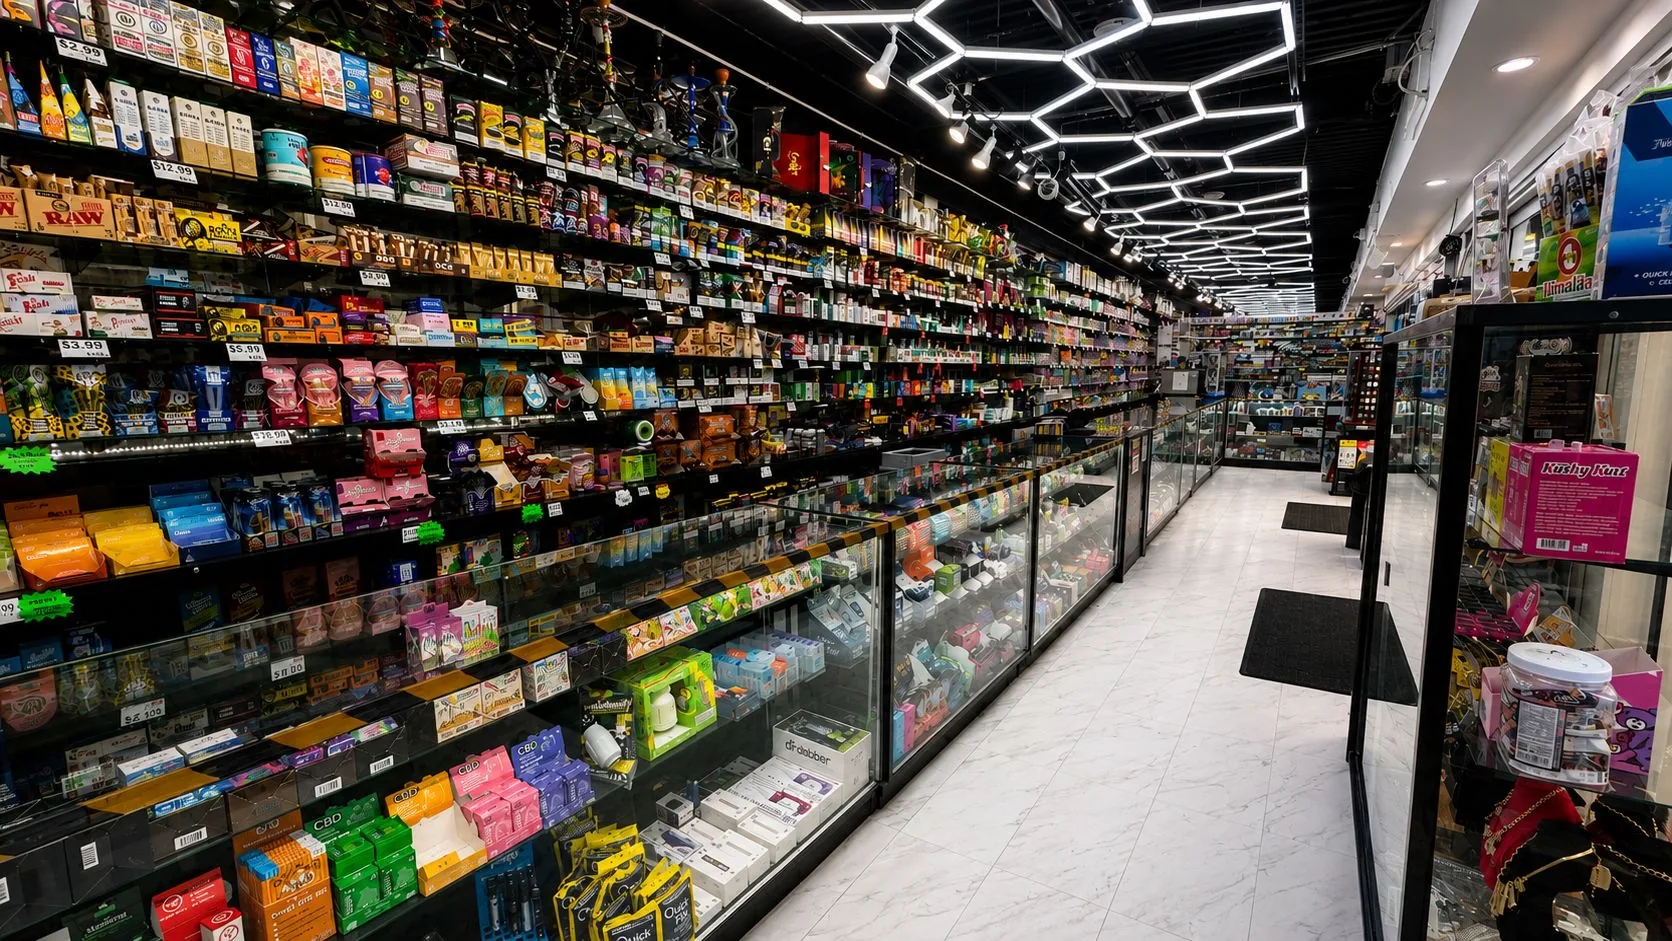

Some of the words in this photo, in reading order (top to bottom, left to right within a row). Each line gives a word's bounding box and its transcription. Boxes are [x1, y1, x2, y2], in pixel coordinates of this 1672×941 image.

[59, 39, 101, 58] $2.99
[43, 211, 103, 226] RAW
[61, 341, 103, 350] $3.99
[1541, 462, 1590, 479] Kushy
[313, 812, 342, 832] CBD
